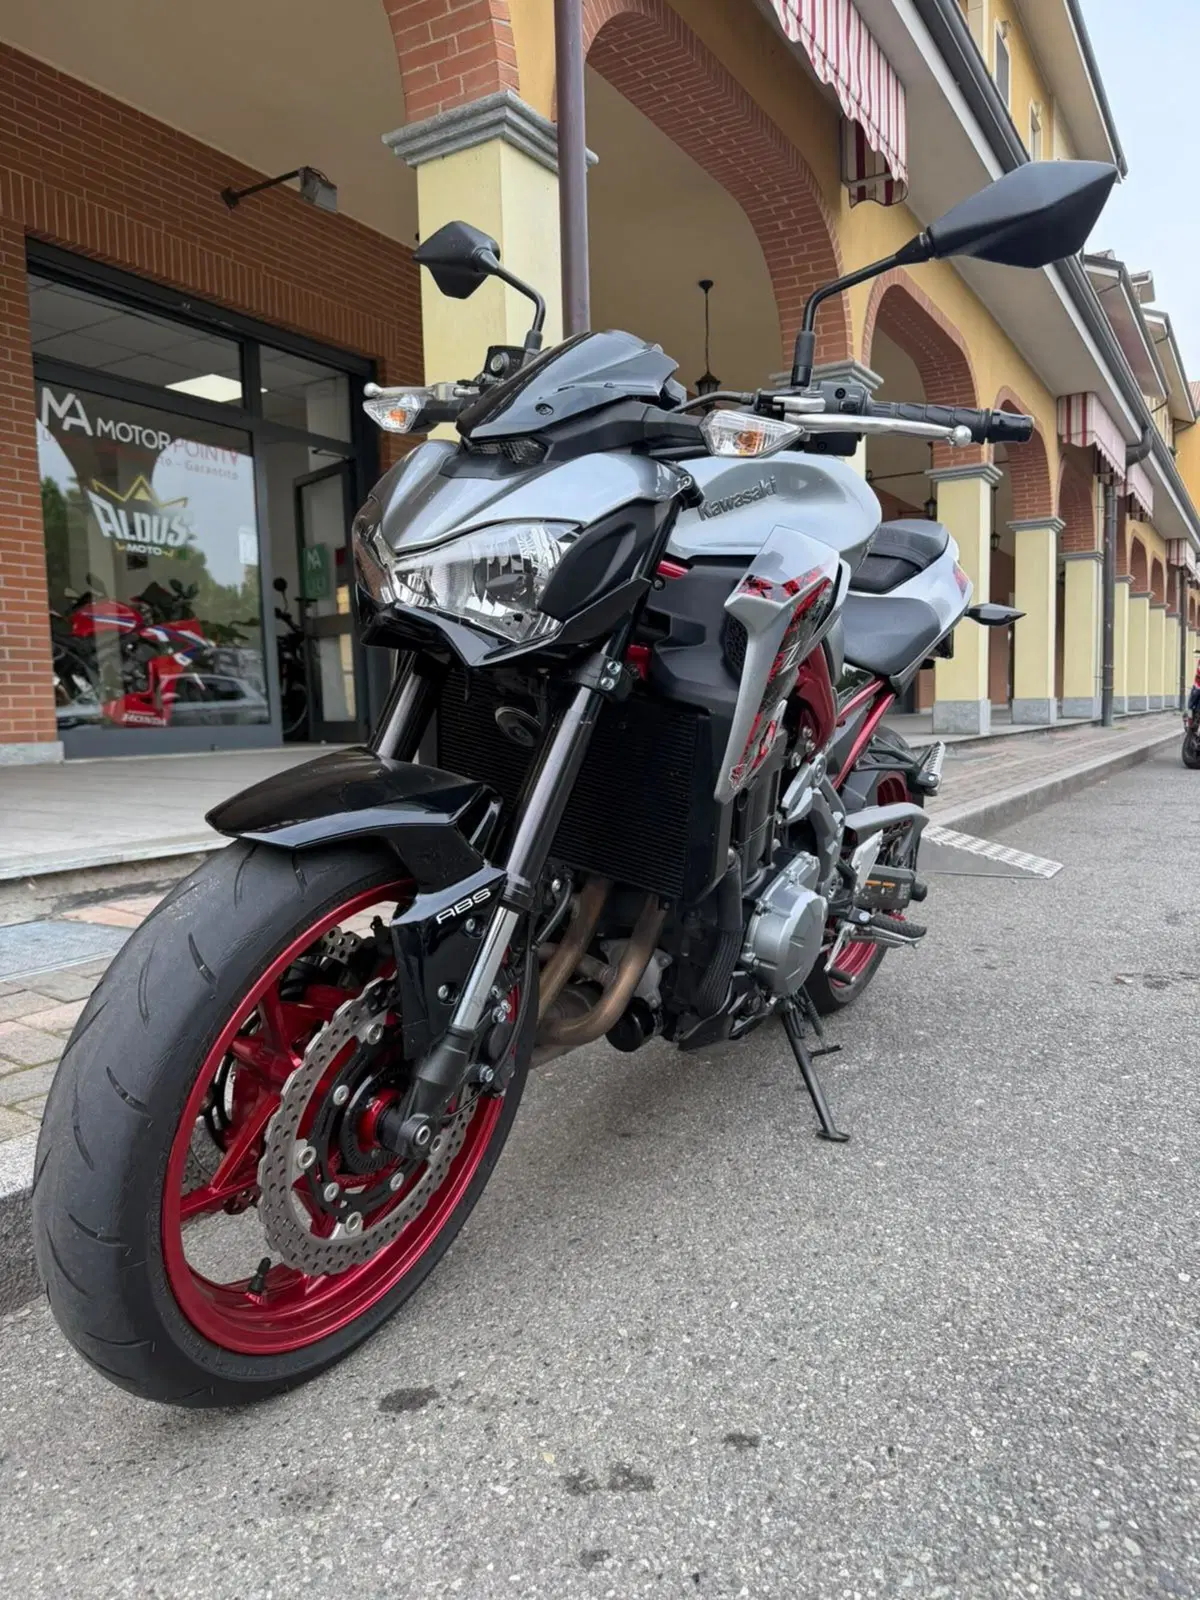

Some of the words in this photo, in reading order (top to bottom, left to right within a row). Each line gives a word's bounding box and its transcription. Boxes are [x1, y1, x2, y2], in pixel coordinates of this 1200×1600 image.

[41, 387, 93, 437] MA
[85, 488, 189, 547] ALDUS
[697, 475, 777, 521] Kawasaki
[126, 543, 163, 556] MOTO
[436, 888, 491, 925] ABS
